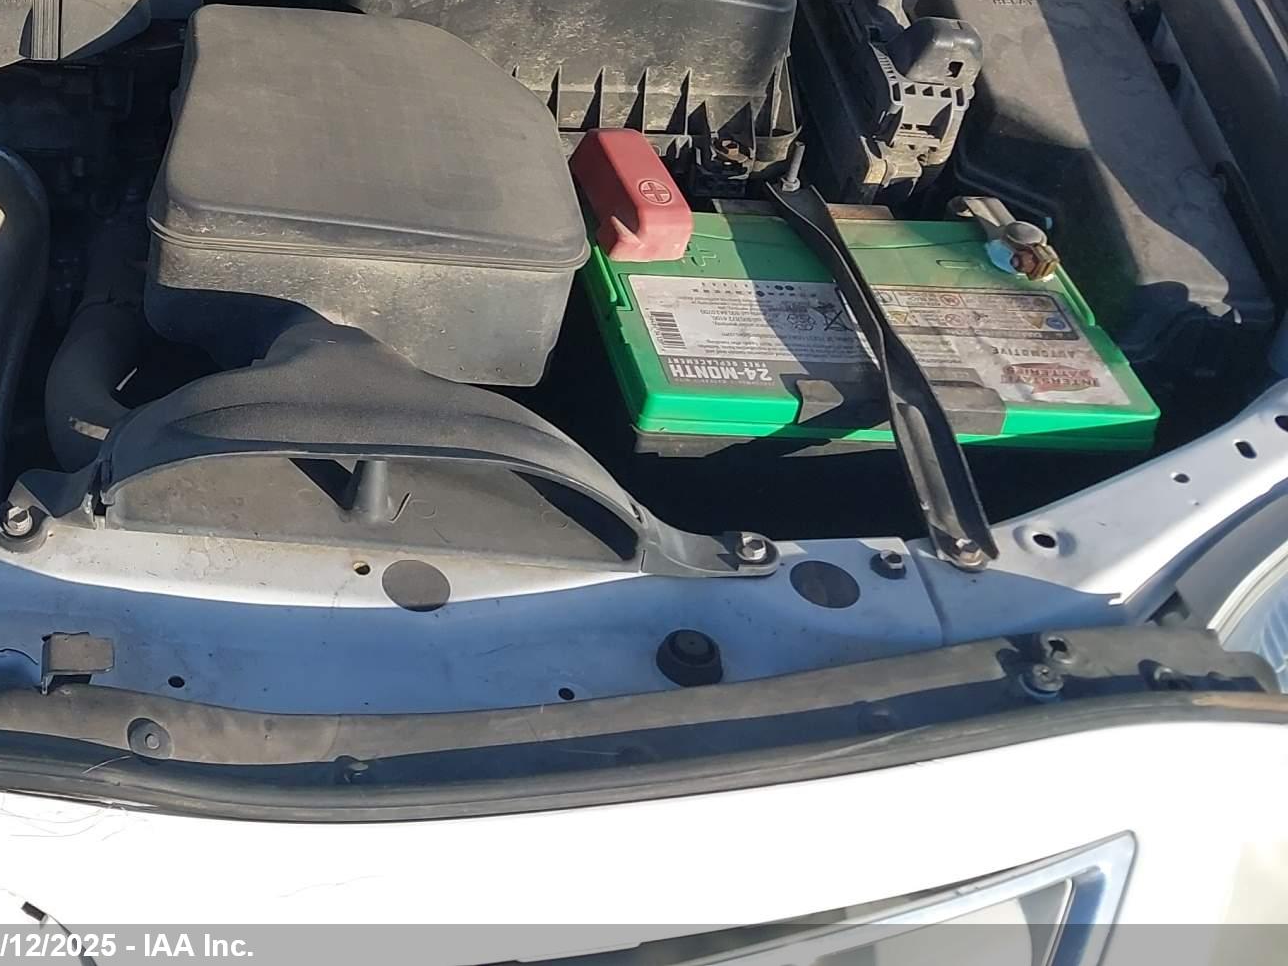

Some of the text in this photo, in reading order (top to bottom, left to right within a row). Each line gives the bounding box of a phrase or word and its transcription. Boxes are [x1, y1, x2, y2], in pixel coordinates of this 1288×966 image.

[991, 347, 1077, 359] AUTOMOTIVE
[667, 357, 736, 367] REPLACEMENT
[668, 363, 773, 381] 24-MONTH
[1001, 366, 1092, 379] BATTERIES
[999, 375, 1101, 388] INTERSTATE
